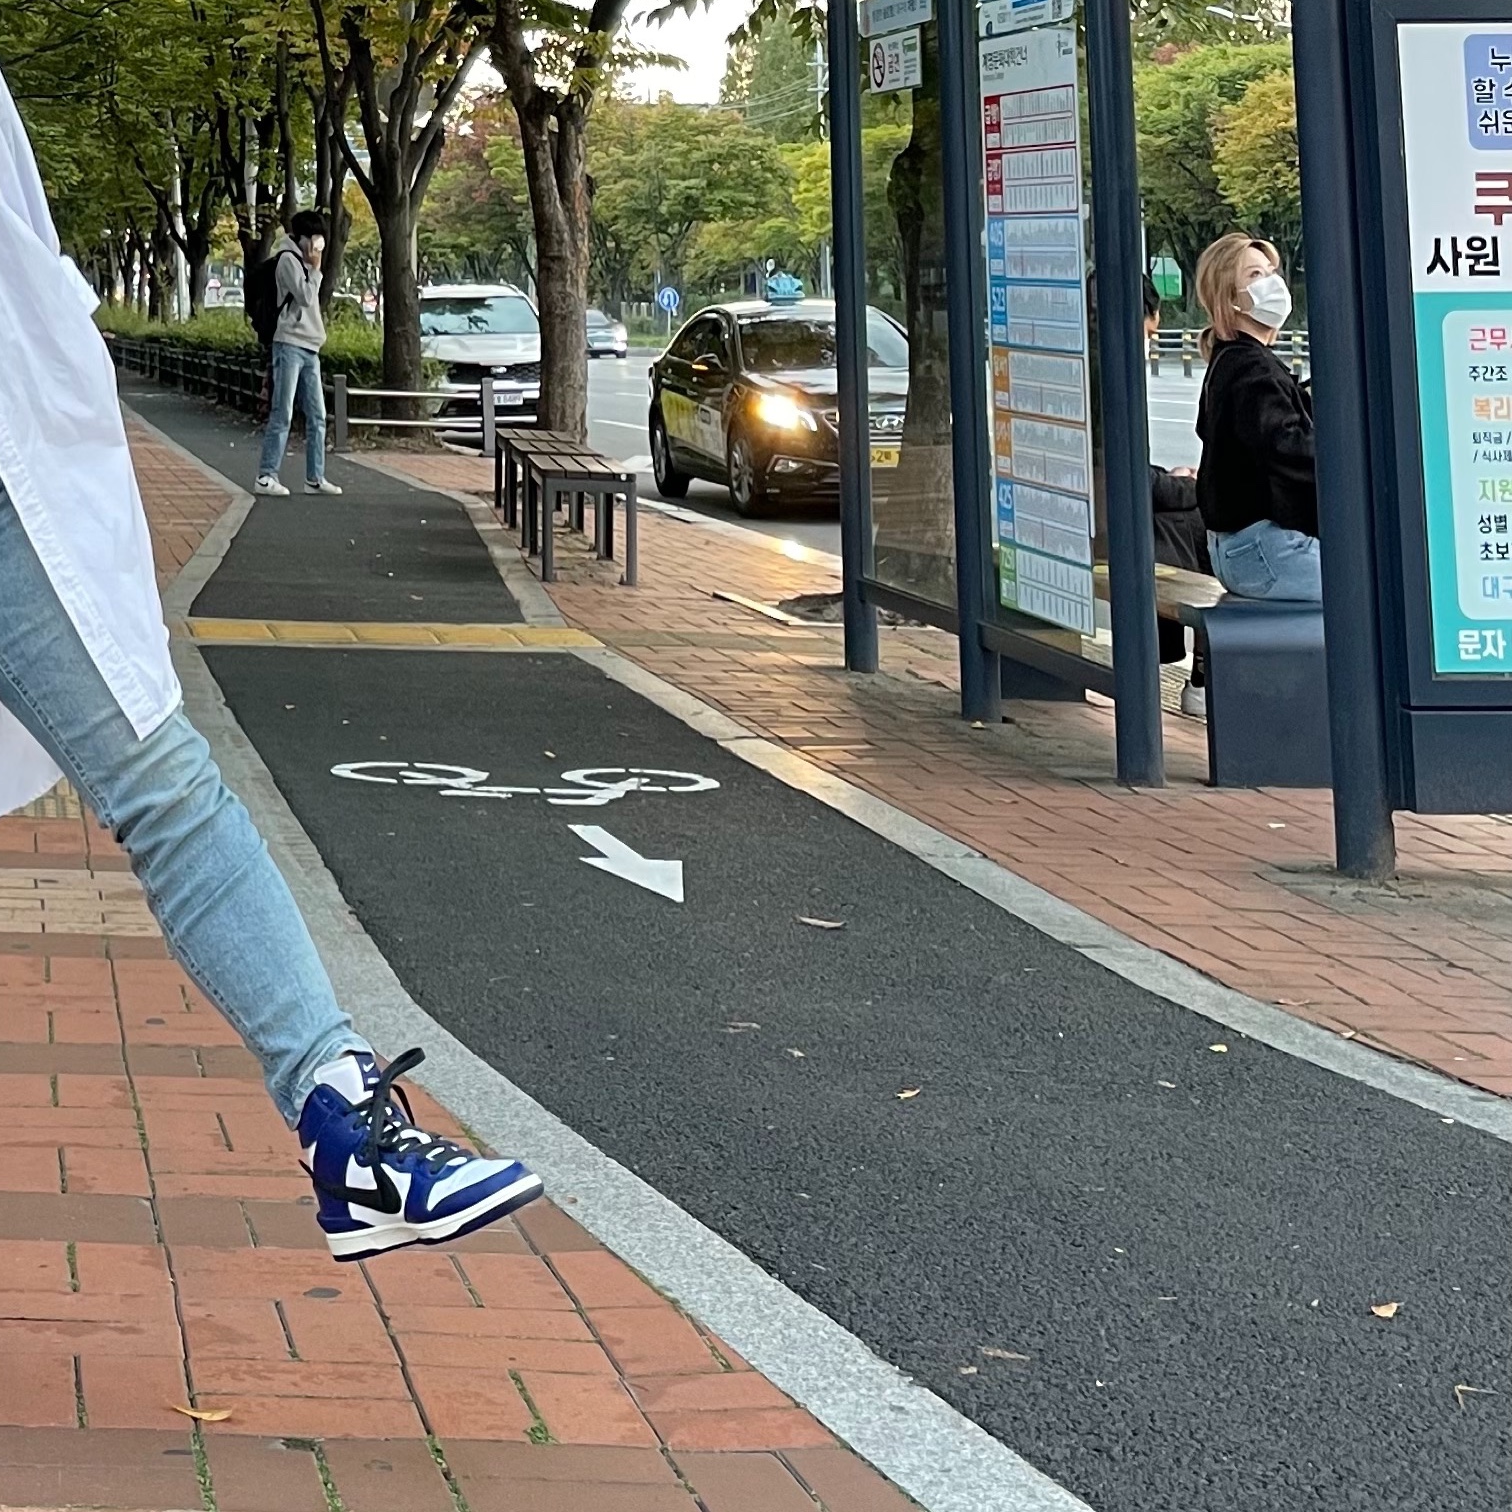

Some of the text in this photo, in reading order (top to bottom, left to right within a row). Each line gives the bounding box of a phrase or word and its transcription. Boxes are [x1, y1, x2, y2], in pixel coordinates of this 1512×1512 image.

[1473, 77, 1497, 104] 할
[1426, 235, 1501, 277] 사원
[1469, 328, 1512, 351] 근무
[1468, 365, 1508, 382] 주간조
[1478, 514, 1508, 534] 성별
[1480, 540, 1512, 561] 초보
[1458, 629, 1507, 661] 문자
